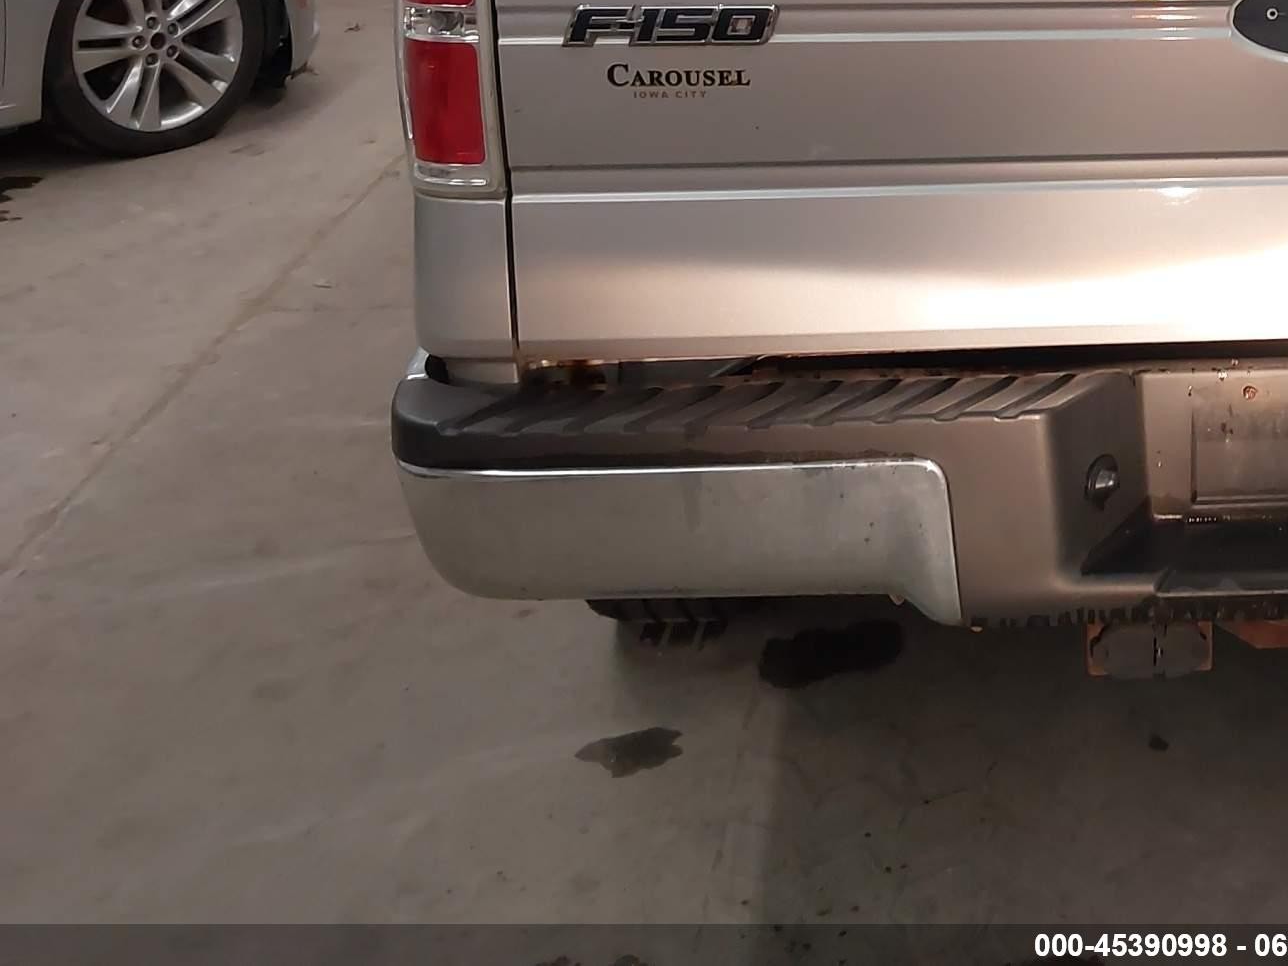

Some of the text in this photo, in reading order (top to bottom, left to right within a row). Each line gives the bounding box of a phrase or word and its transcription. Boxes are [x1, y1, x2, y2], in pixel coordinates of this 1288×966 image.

[562, 3, 780, 47] F-150
[607, 63, 751, 87] CAROUSEL
[633, 90, 708, 99] IOWA CITY
